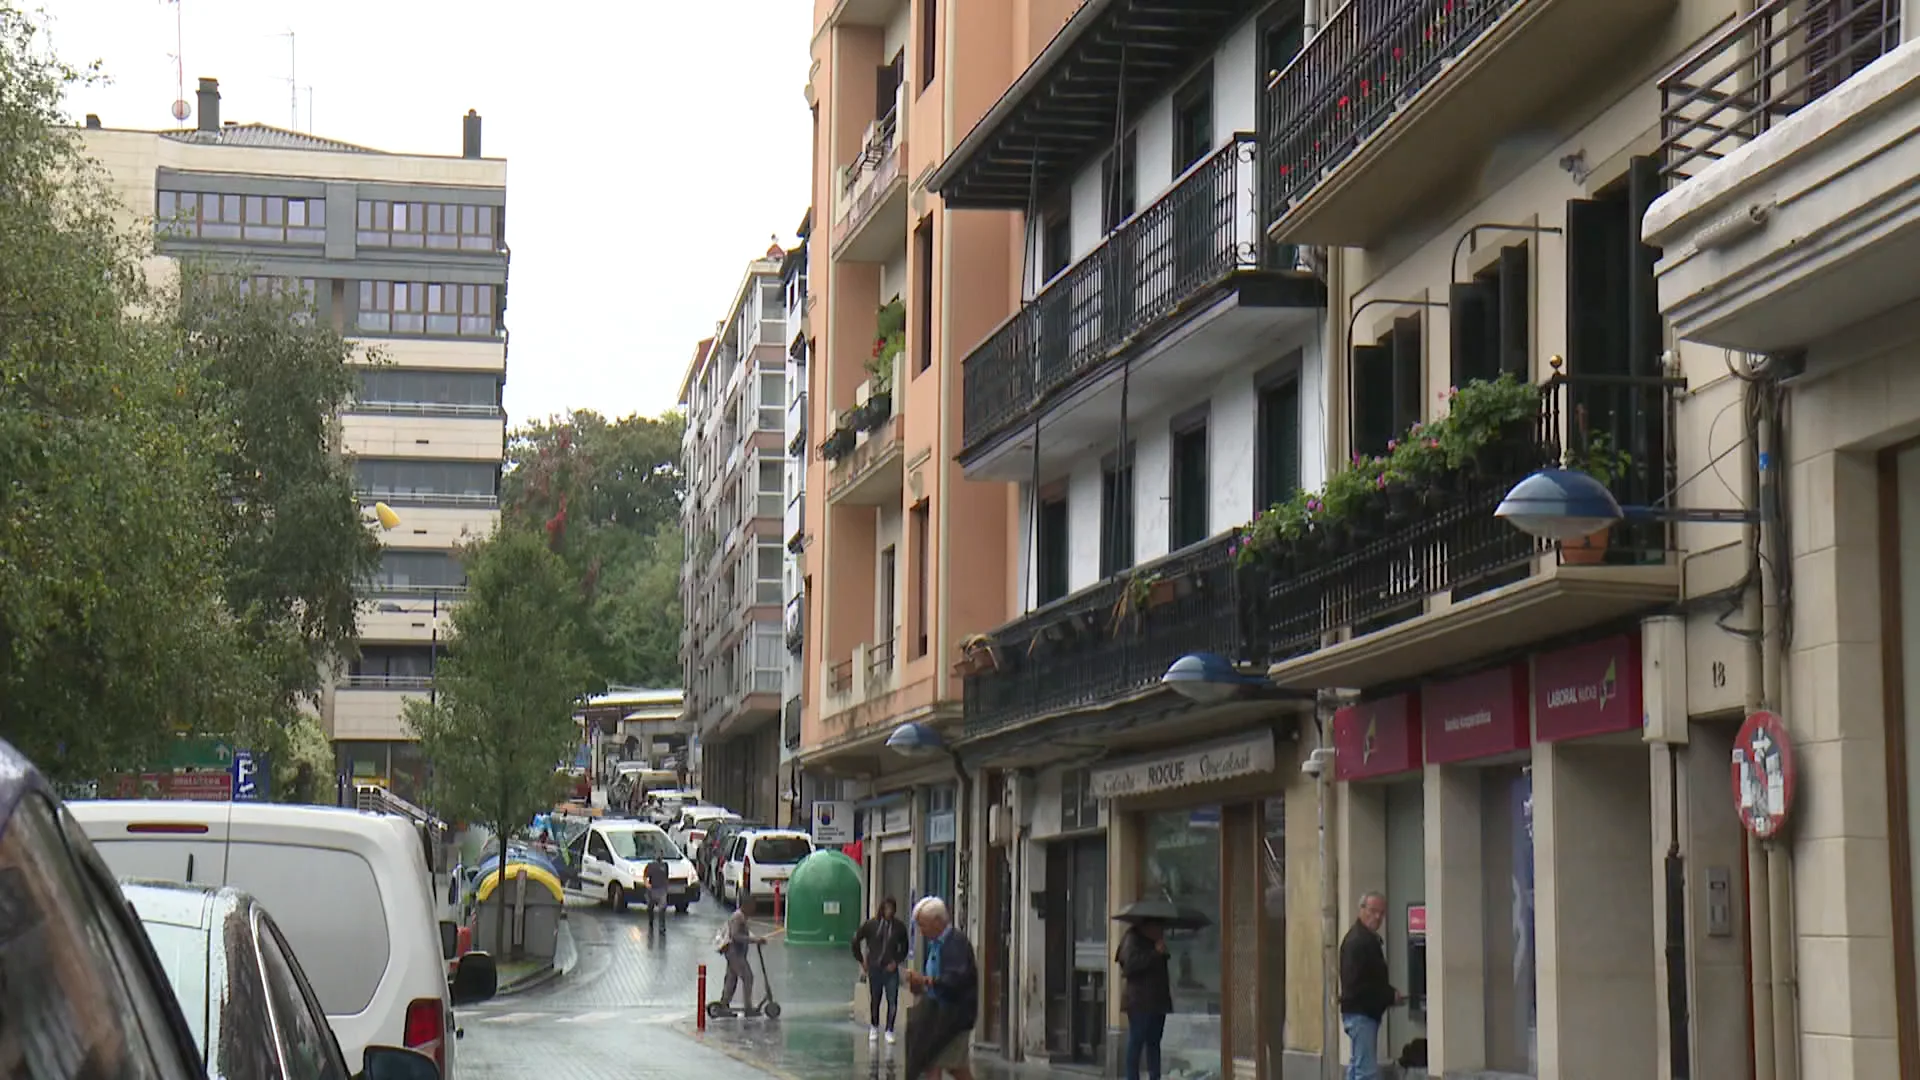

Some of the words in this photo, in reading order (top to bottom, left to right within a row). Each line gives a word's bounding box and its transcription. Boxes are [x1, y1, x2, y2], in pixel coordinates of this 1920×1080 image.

[1712, 661, 1726, 688] 18
[1546, 687, 1577, 708] LABORAL
[238, 759, 258, 784] P
[1148, 761, 1185, 785] ROQUE
